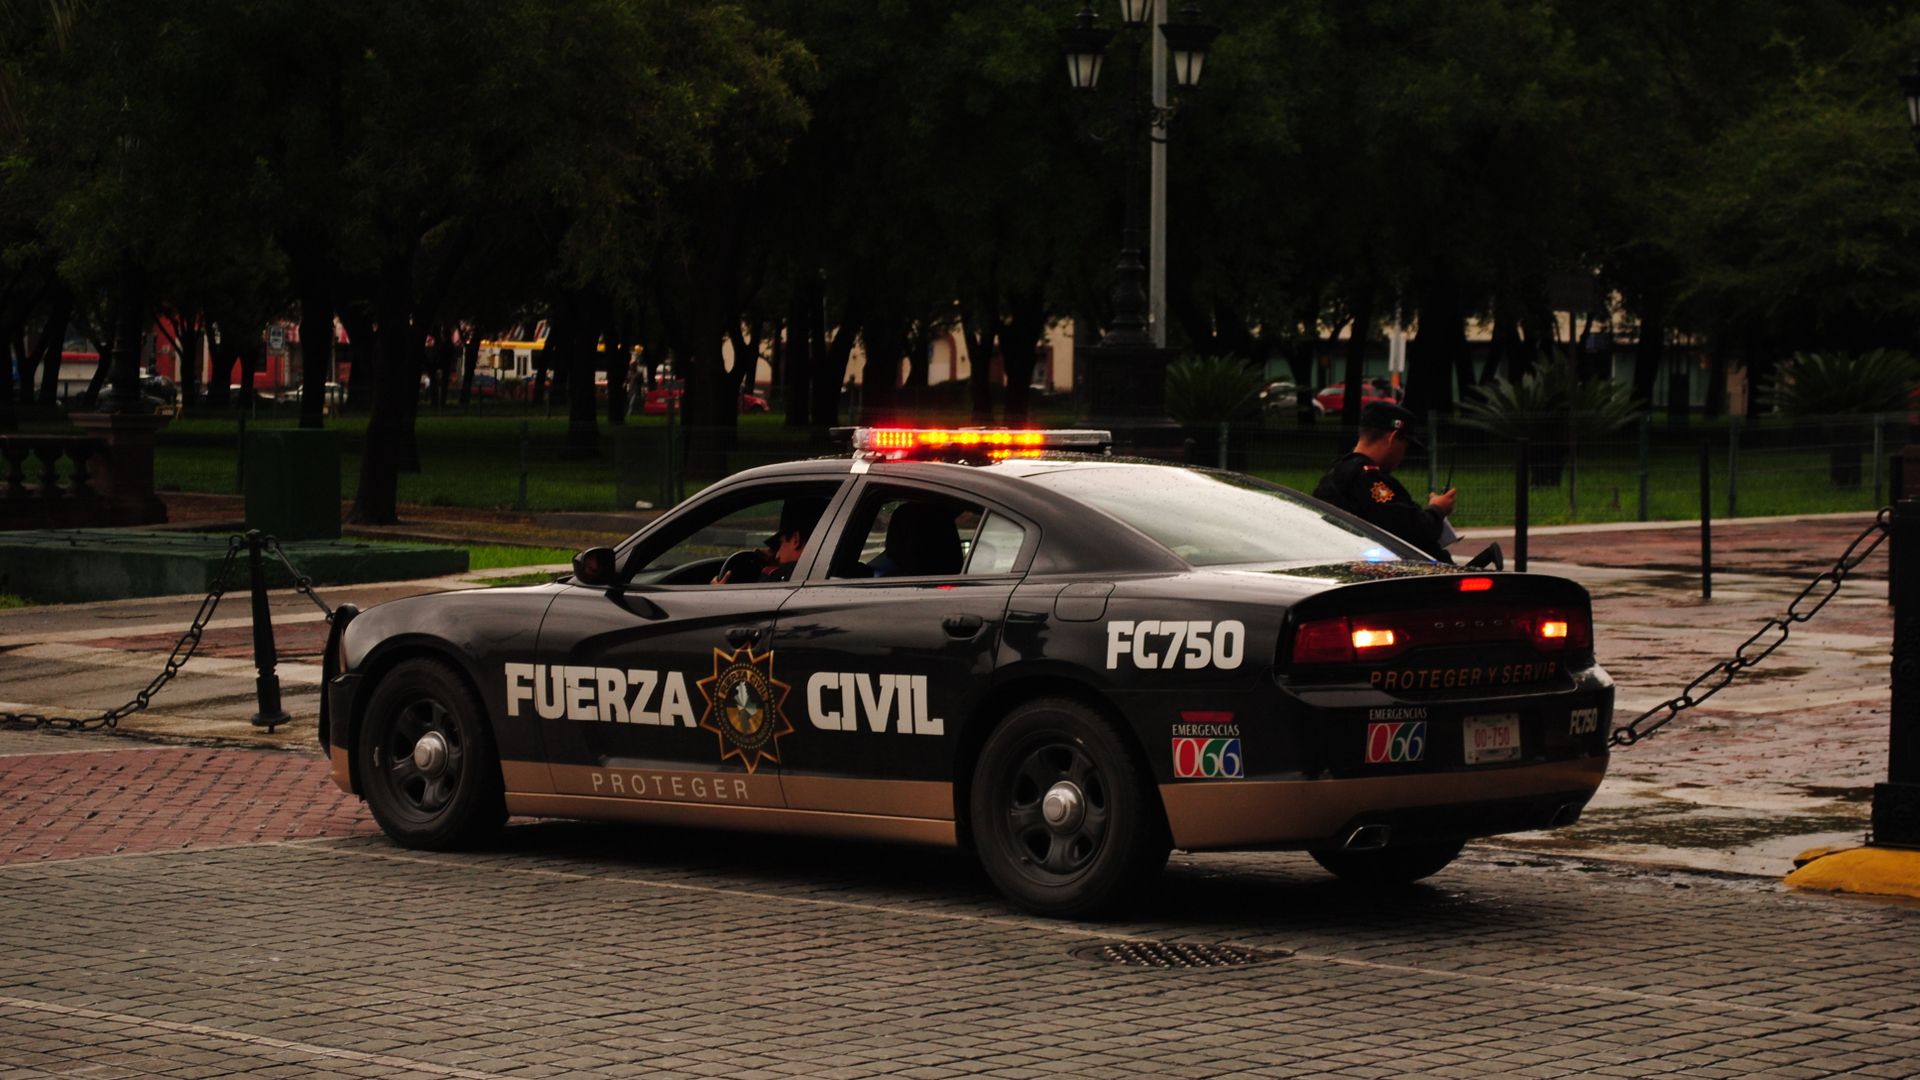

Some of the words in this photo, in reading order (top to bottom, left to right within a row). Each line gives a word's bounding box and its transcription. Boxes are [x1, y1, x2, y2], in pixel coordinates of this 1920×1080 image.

[1106, 619, 1245, 670] FC750
[1370, 667, 1481, 689] PROTEGER
[1487, 666, 1499, 688] Y
[1501, 661, 1557, 684] SERVIR
[505, 662, 697, 728] FUERZA
[806, 671, 944, 736] CIVIL
[1368, 706, 1428, 721] EMERGENCIAS
[1569, 707, 1598, 735] FC750
[1171, 724, 1241, 737] EMERGENCIAS
[1368, 721, 1425, 763] 066
[1174, 737, 1241, 778] 066
[591, 772, 749, 800] PROTEGER
